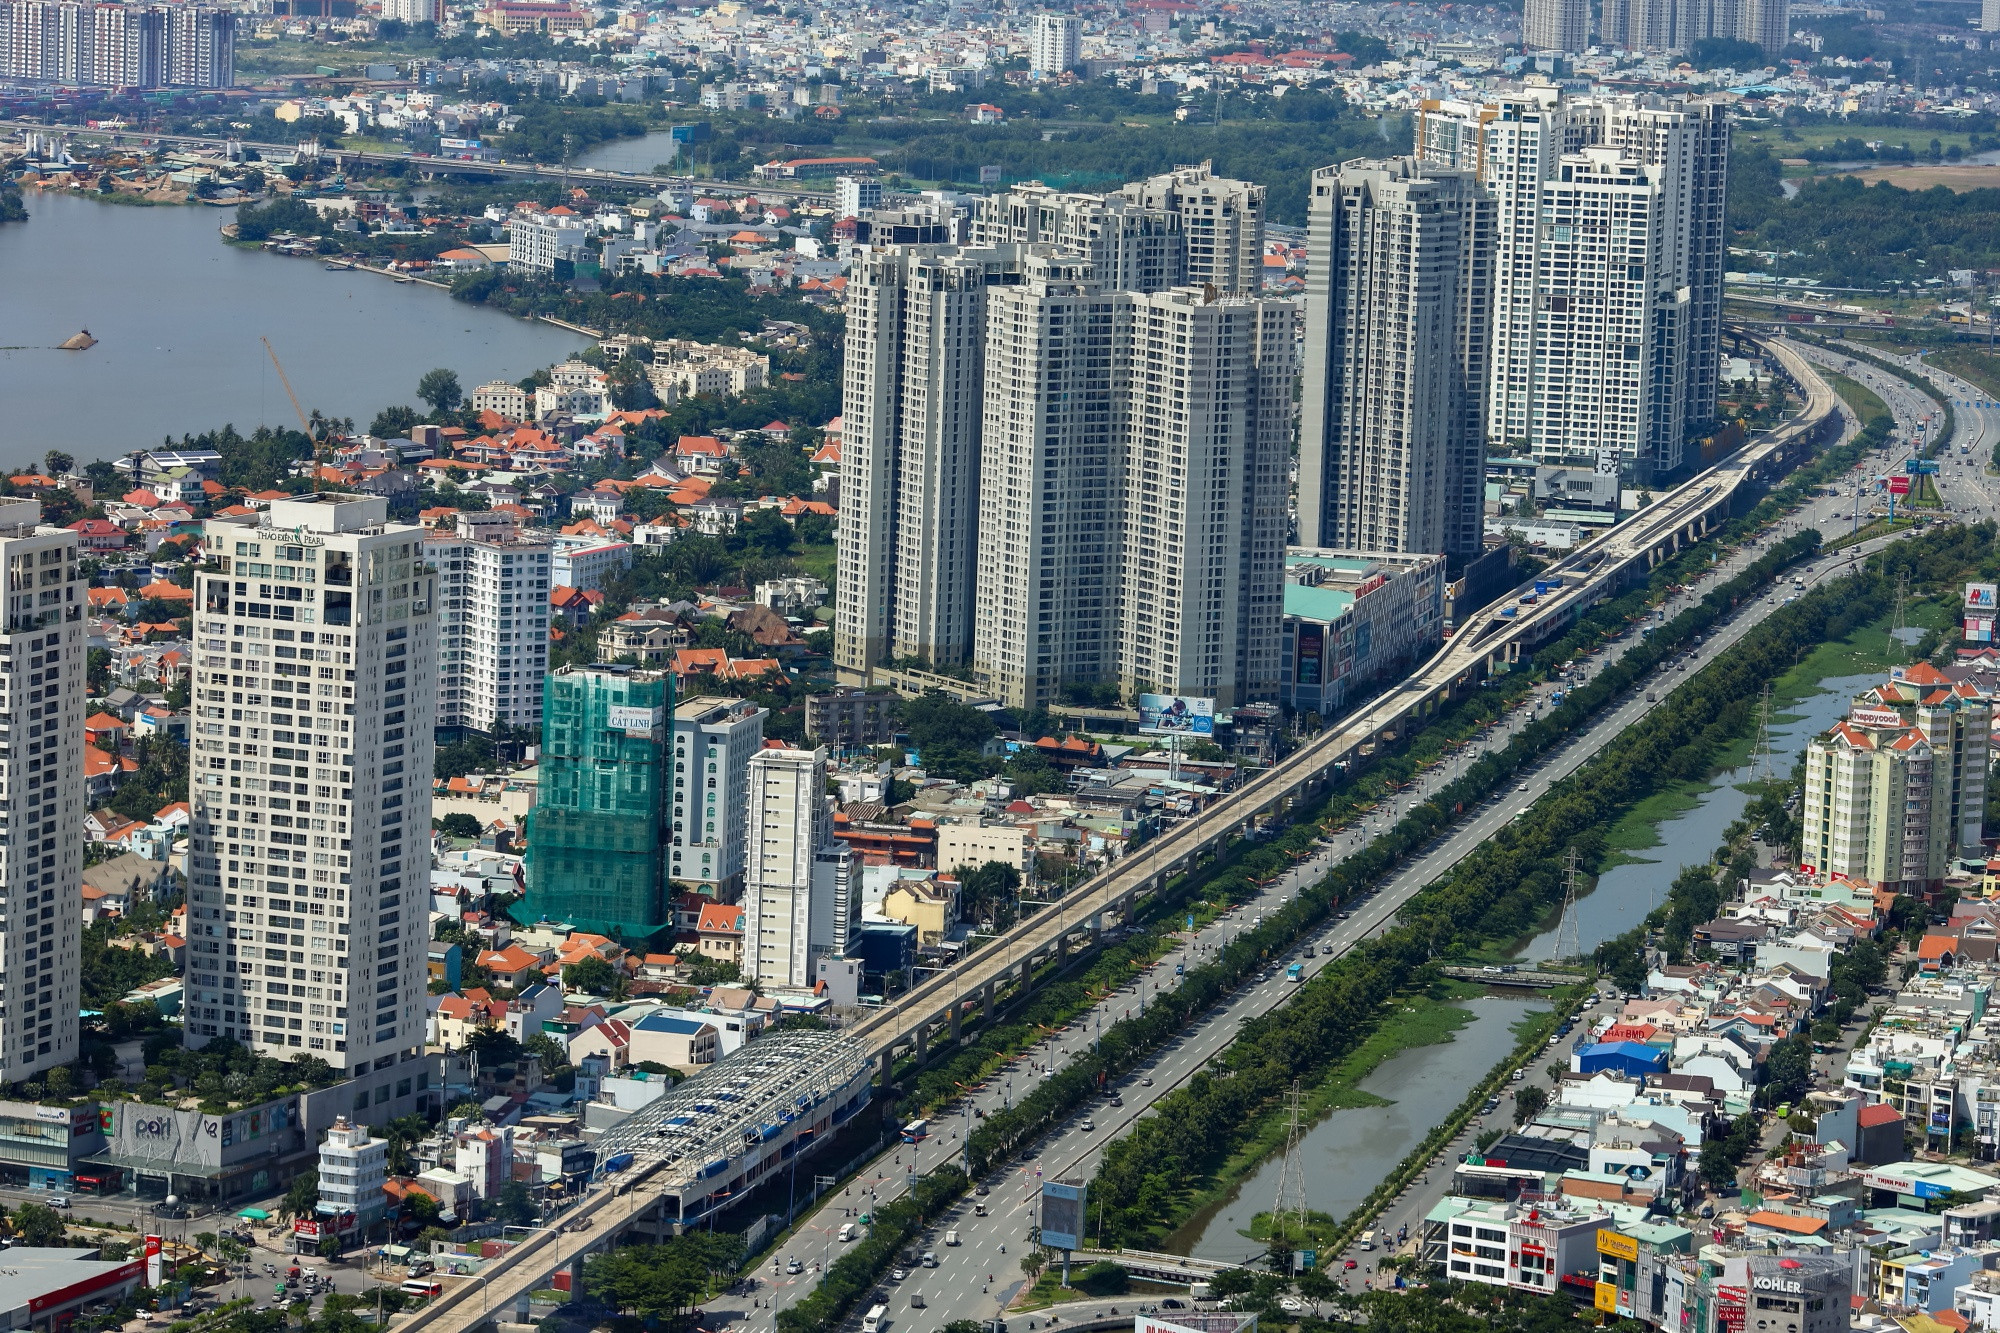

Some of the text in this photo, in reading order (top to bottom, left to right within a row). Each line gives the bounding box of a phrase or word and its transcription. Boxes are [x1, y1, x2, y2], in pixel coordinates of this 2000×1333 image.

[304, 535, 325, 545] PEARL
[612, 715, 650, 728] CÁT LINH
[1625, 1029, 1645, 1039] BMD
[1804, 1143, 1826, 1153] HOTEL
[1754, 1276, 1801, 1294] KOHLER
